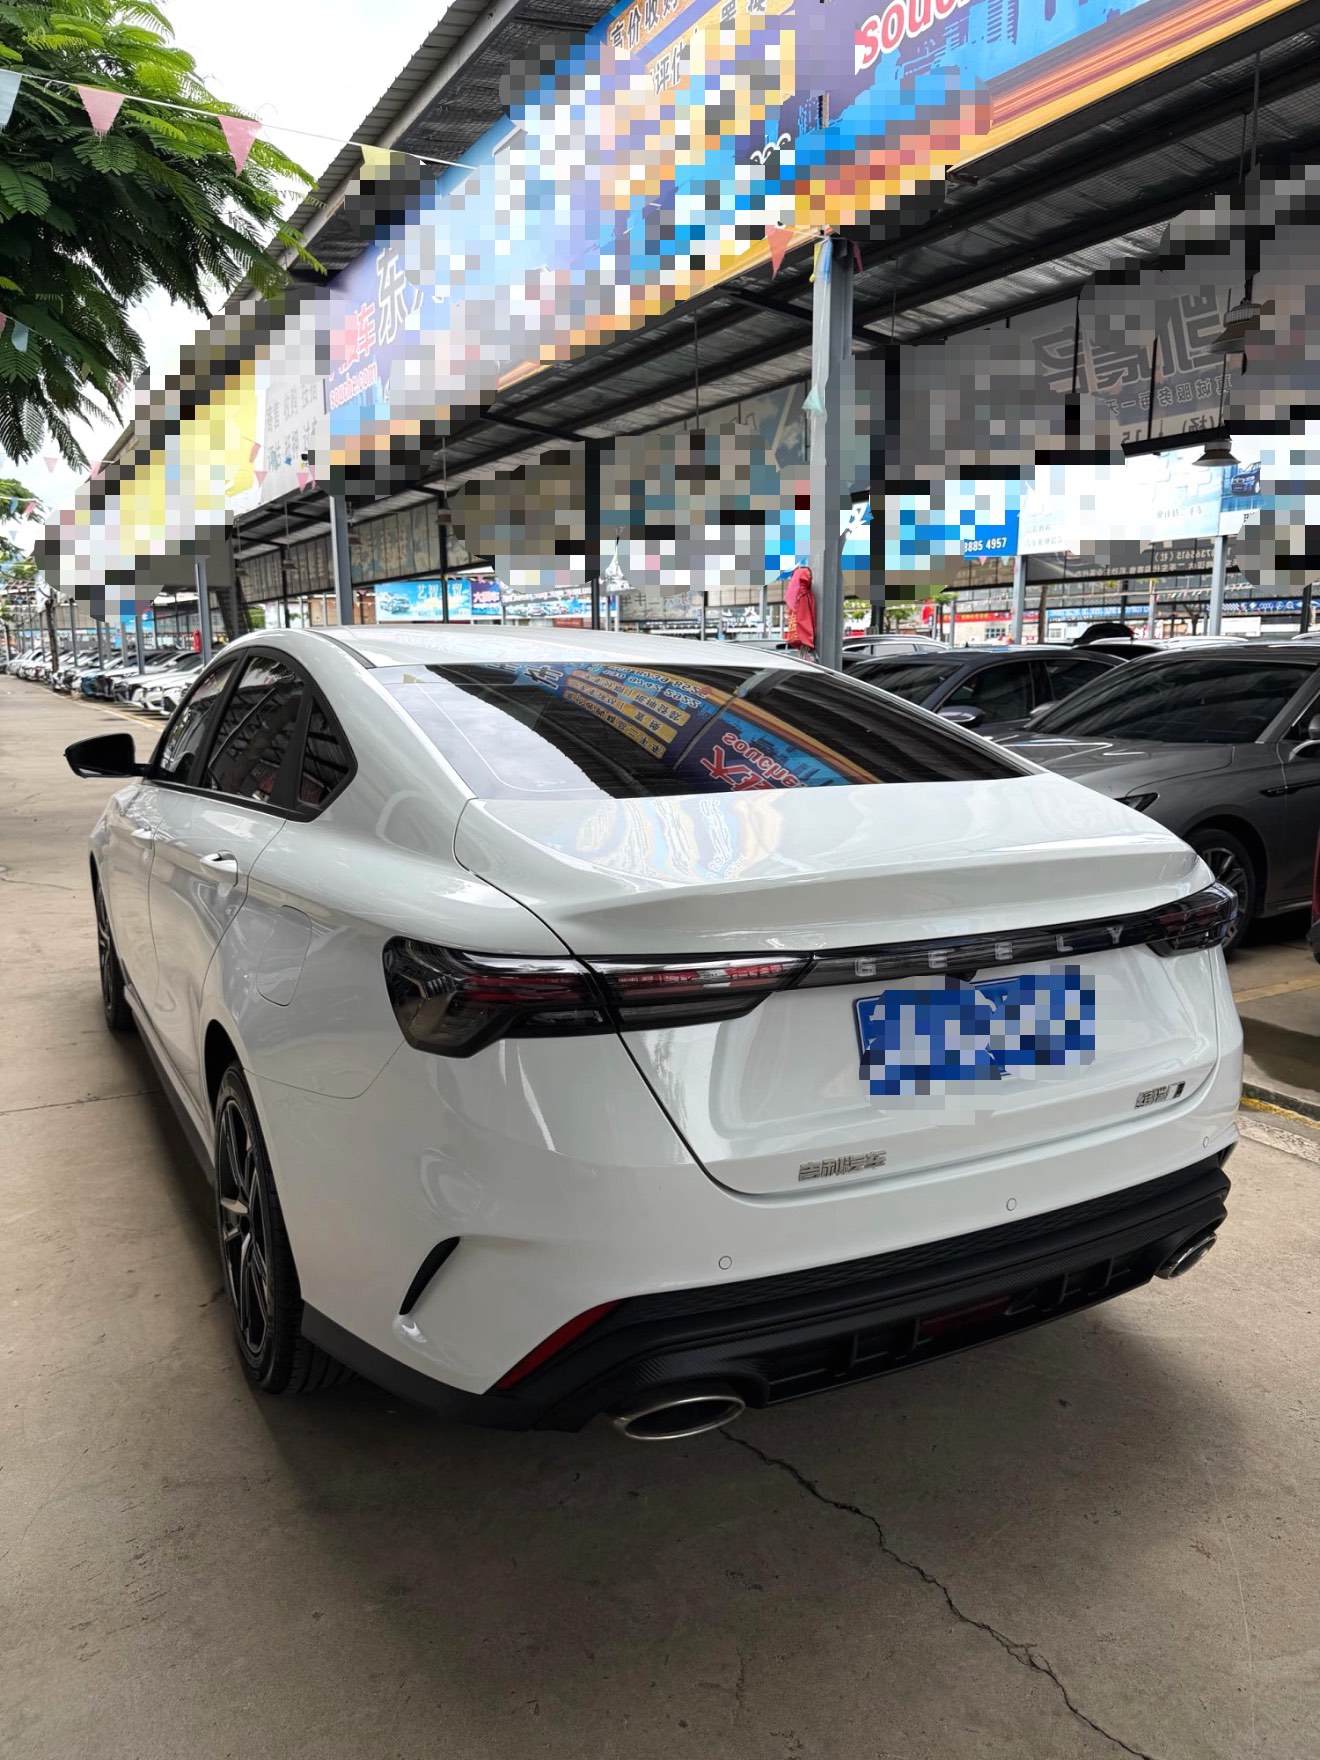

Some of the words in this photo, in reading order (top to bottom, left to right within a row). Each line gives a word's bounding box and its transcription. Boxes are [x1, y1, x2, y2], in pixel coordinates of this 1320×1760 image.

[985, 537, 1007, 550] 4957
[854, 925, 1124, 977] GEELY
[798, 1150, 887, 1182] 吉利汽车
